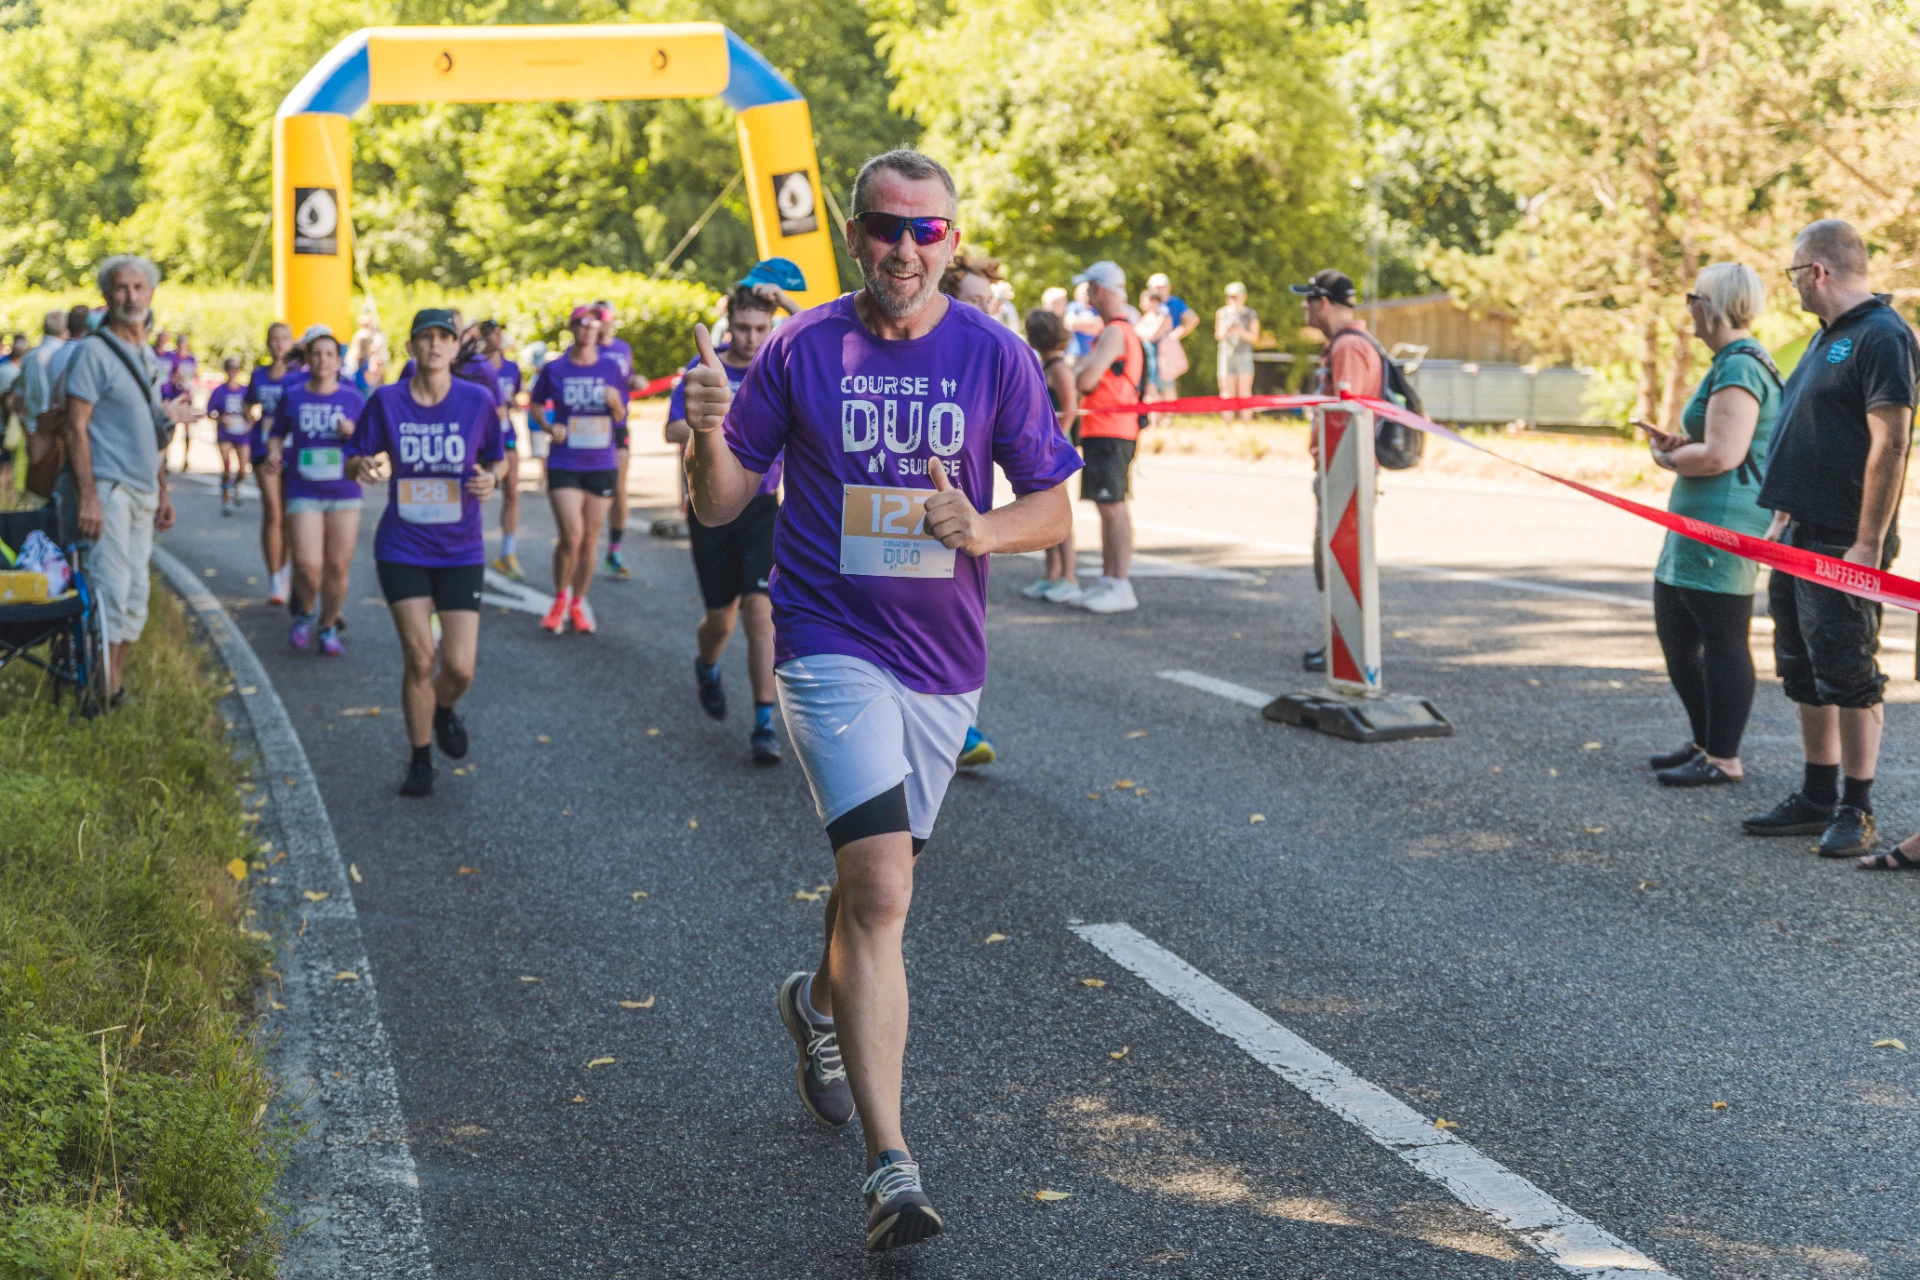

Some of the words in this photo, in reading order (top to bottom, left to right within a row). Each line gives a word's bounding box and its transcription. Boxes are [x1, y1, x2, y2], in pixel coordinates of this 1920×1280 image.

[841, 375, 929, 396] COURSE
[842, 400, 965, 456] DUO
[400, 434, 466, 463] DUO
[898, 458, 961, 477] SUISE
[410, 481, 448, 502] 128
[1684, 517, 1740, 549] RAIFFEISEN
[883, 540, 911, 548] COURSE
[883, 549, 921, 565] DUO
[1815, 558, 1882, 593] RAIFFEISEN
